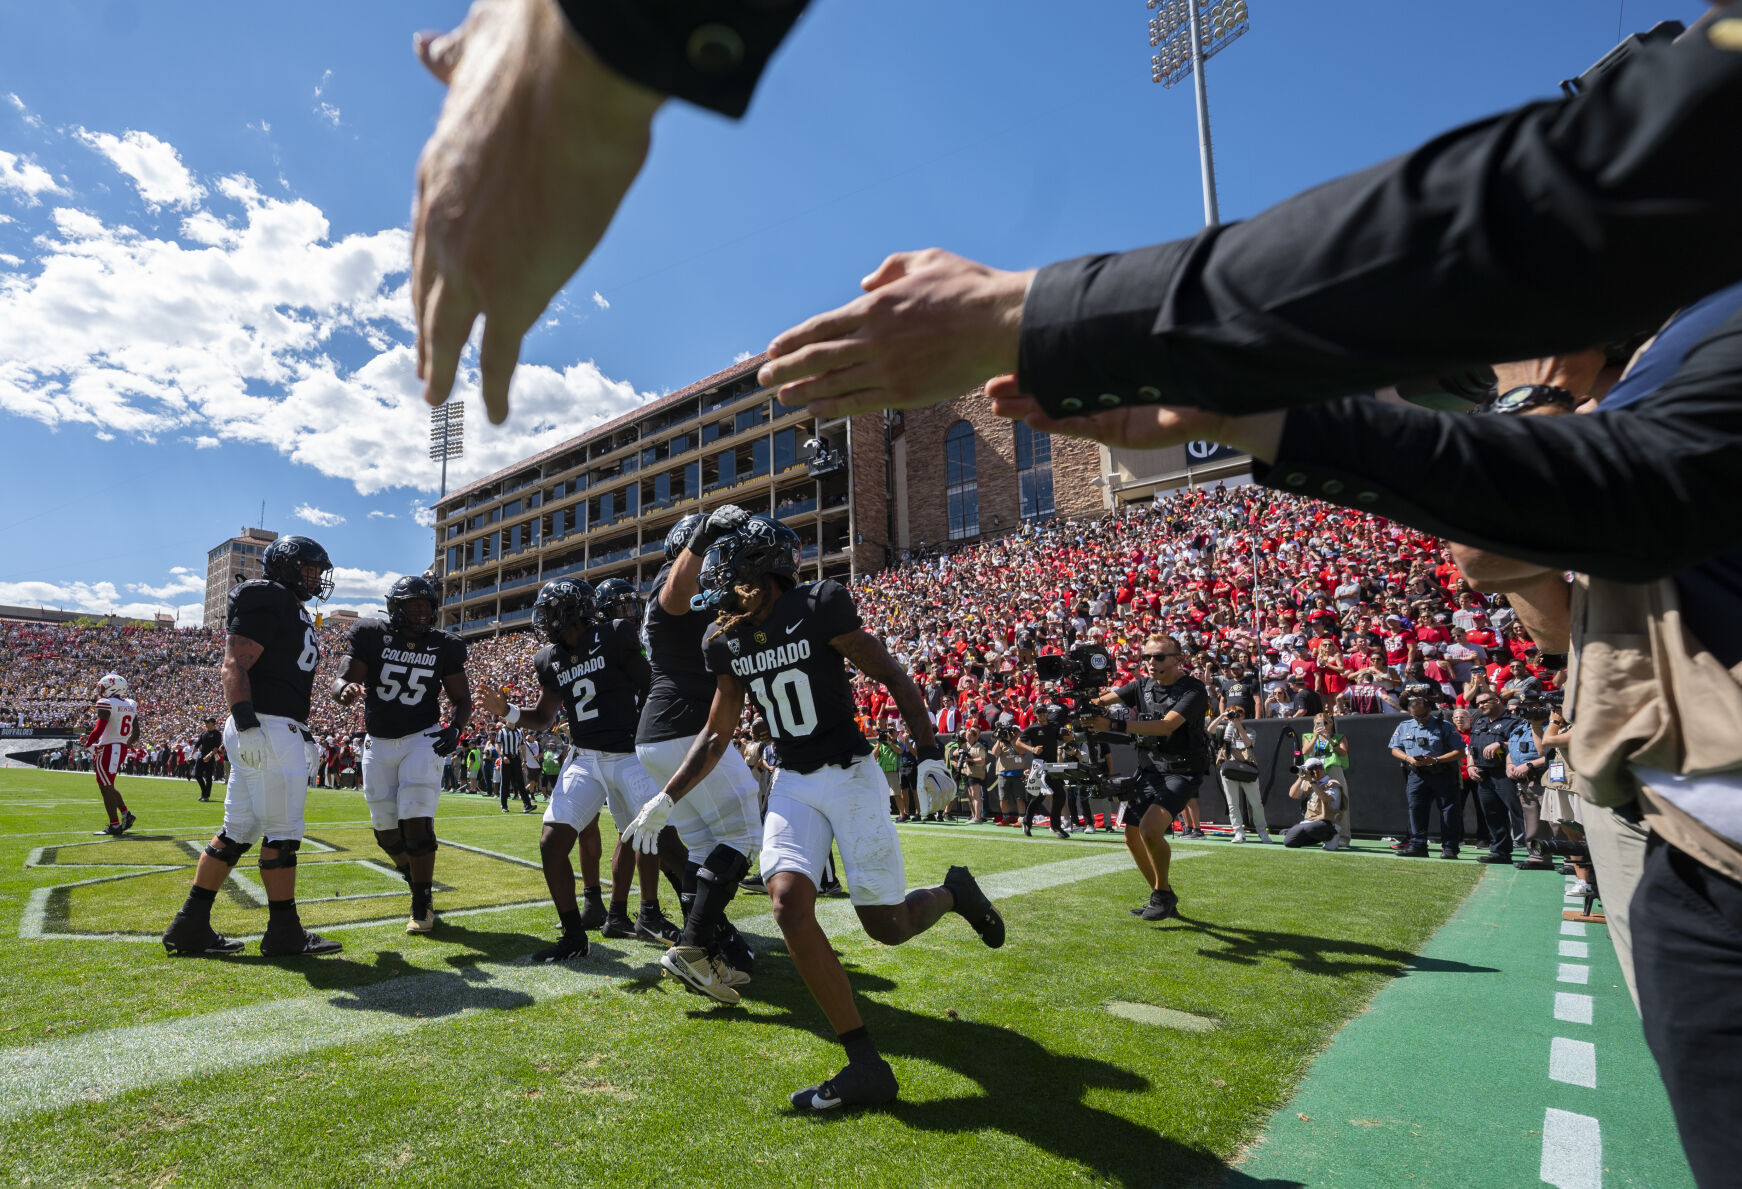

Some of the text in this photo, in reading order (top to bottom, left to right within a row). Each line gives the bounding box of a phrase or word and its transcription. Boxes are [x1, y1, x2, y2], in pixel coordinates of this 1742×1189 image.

[381, 647, 437, 667] COLORADO
[556, 655, 606, 687] COLORADO
[730, 639, 811, 677] COLORADO
[376, 662, 435, 706] 55
[572, 677, 599, 722] 2
[750, 668, 818, 738] 10
[1, 728, 34, 736] BUFFALOES
[120, 715, 132, 737] 6
